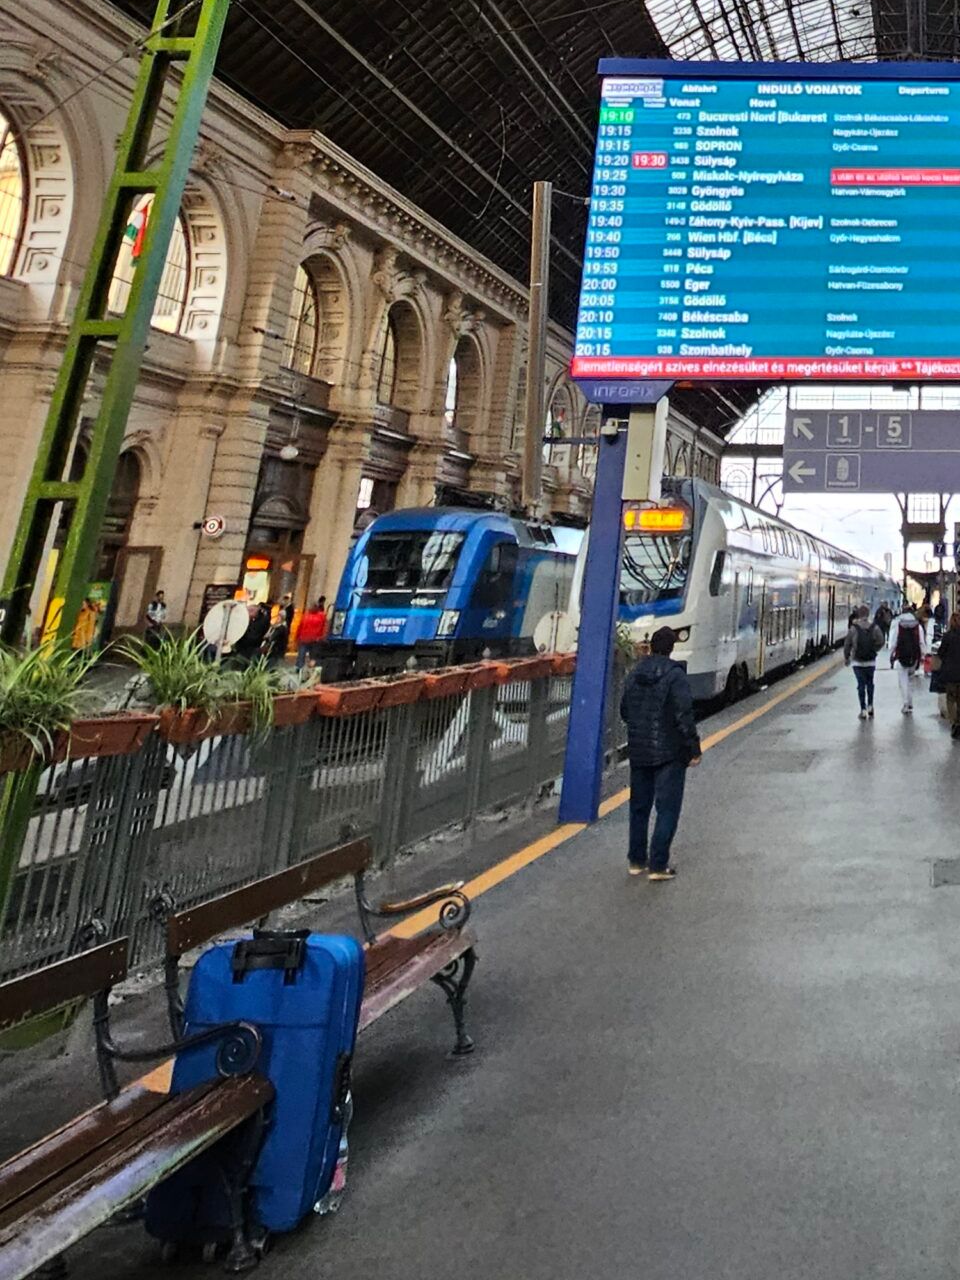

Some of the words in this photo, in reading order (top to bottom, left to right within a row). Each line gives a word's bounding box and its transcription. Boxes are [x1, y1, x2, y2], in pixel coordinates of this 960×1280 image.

[682, 85, 717, 93] Abfahrt
[758, 83, 803, 94] INDULÓ
[806, 85, 862, 95] VONATOK
[899, 86, 949, 96] Departures
[670, 98, 700, 107] Vonat
[750, 98, 776, 108] Hová
[601, 111, 633, 121] 19:10
[751, 112, 776, 122] Nord
[600, 126, 631, 136] 19:15
[696, 126, 739, 136] Szolnok
[599, 141, 630, 151] 19:15
[696, 141, 742, 151] SOPRON
[598, 156, 629, 165] 19:20
[633, 155, 665, 166] 19:30
[694, 155, 736, 167] Sülysáp
[596, 171, 627, 181] 19:25
[595, 185, 625, 196] 19:30
[691, 186, 744, 197] Gyöngyös
[593, 201, 624, 211] 19:35
[691, 201, 731, 212] Gödöllő
[591, 216, 622, 226] 19:40
[589, 232, 621, 242] 19:40
[688, 232, 716, 242] Wien
[718, 231, 740, 243] Hbf.
[587, 247, 620, 258] 19:50
[687, 247, 731, 260] Sülysáp
[585, 263, 618, 274] 19:53
[686, 263, 713, 274] Pécs
[583, 279, 617, 290] 20:00
[684, 280, 710, 292] Eger
[582, 295, 614, 306] 20:05
[684, 295, 726, 307] Gödöllő
[580, 311, 613, 322] 20:10
[682, 311, 748, 323] Békéscsaba
[578, 328, 612, 339] 20:15
[681, 328, 725, 339] Szolnok
[577, 344, 610, 356] 20:15
[680, 344, 751, 358] Szombathely
[770, 361, 784, 373] és
[838, 415, 848, 437] 1
[887, 416, 902, 438] 5
